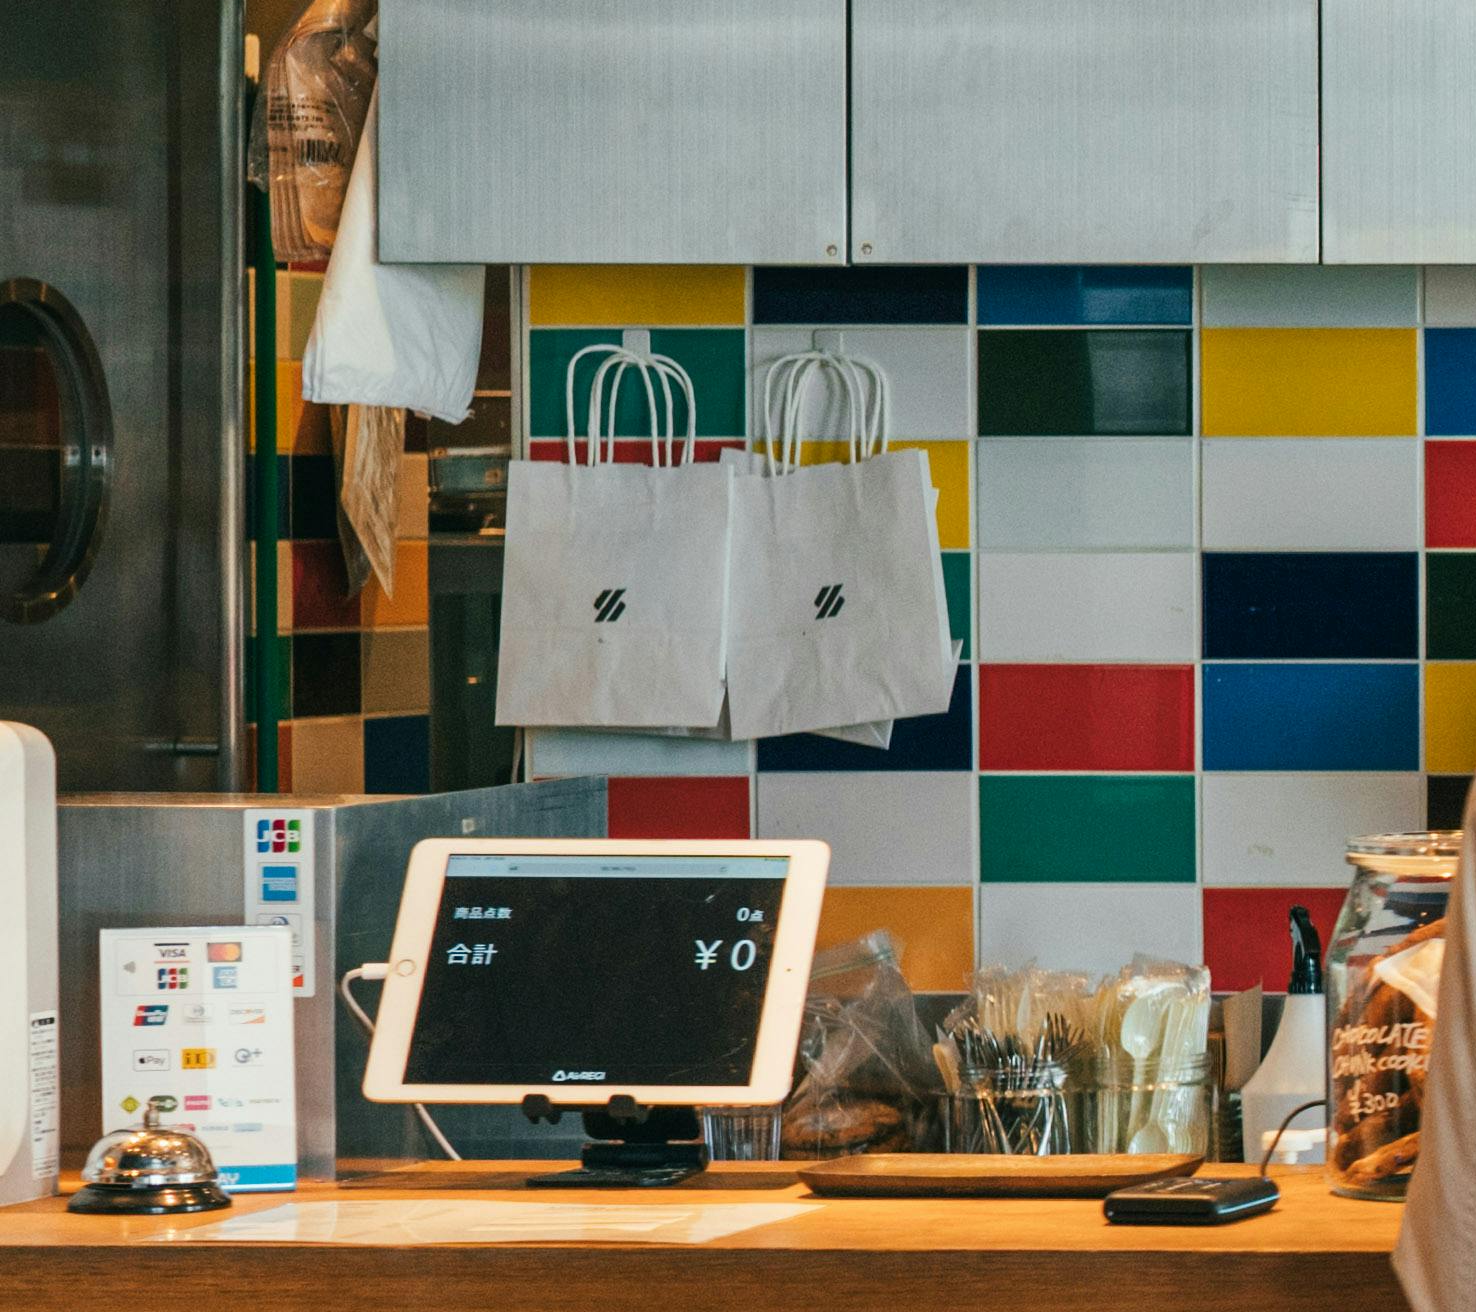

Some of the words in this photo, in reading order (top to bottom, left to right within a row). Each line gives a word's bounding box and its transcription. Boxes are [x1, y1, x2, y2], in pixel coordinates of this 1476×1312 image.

[453, 906, 513, 920] 商品点数
[158, 948, 187, 958] VISA
[446, 943, 499, 966] 合計
